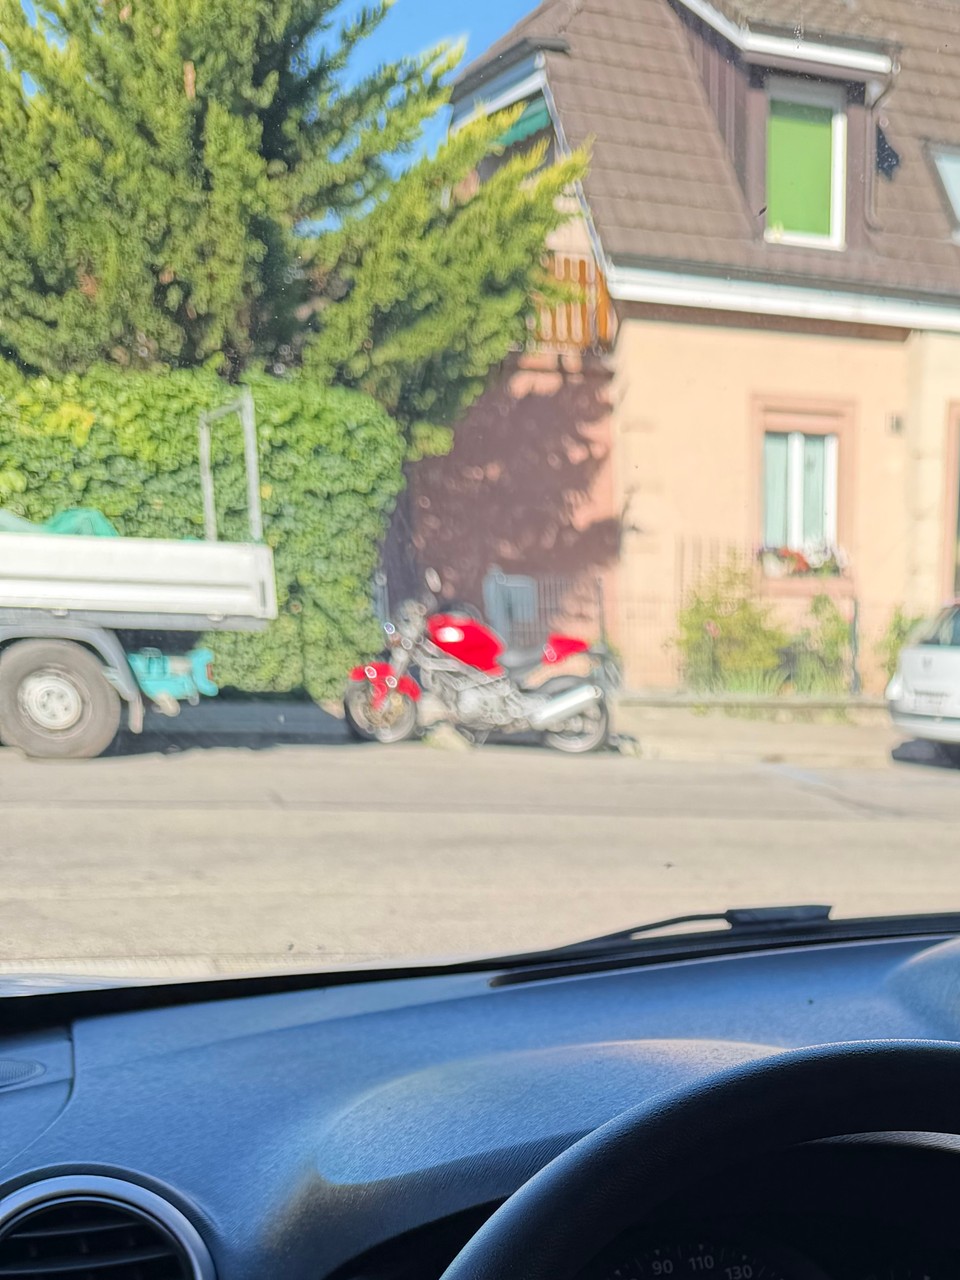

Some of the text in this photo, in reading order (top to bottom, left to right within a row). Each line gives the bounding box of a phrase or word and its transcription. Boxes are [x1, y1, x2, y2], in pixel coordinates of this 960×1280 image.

[651, 1259, 674, 1276] 90
[688, 1254, 714, 1271] 110
[724, 1264, 753, 1280] 130
